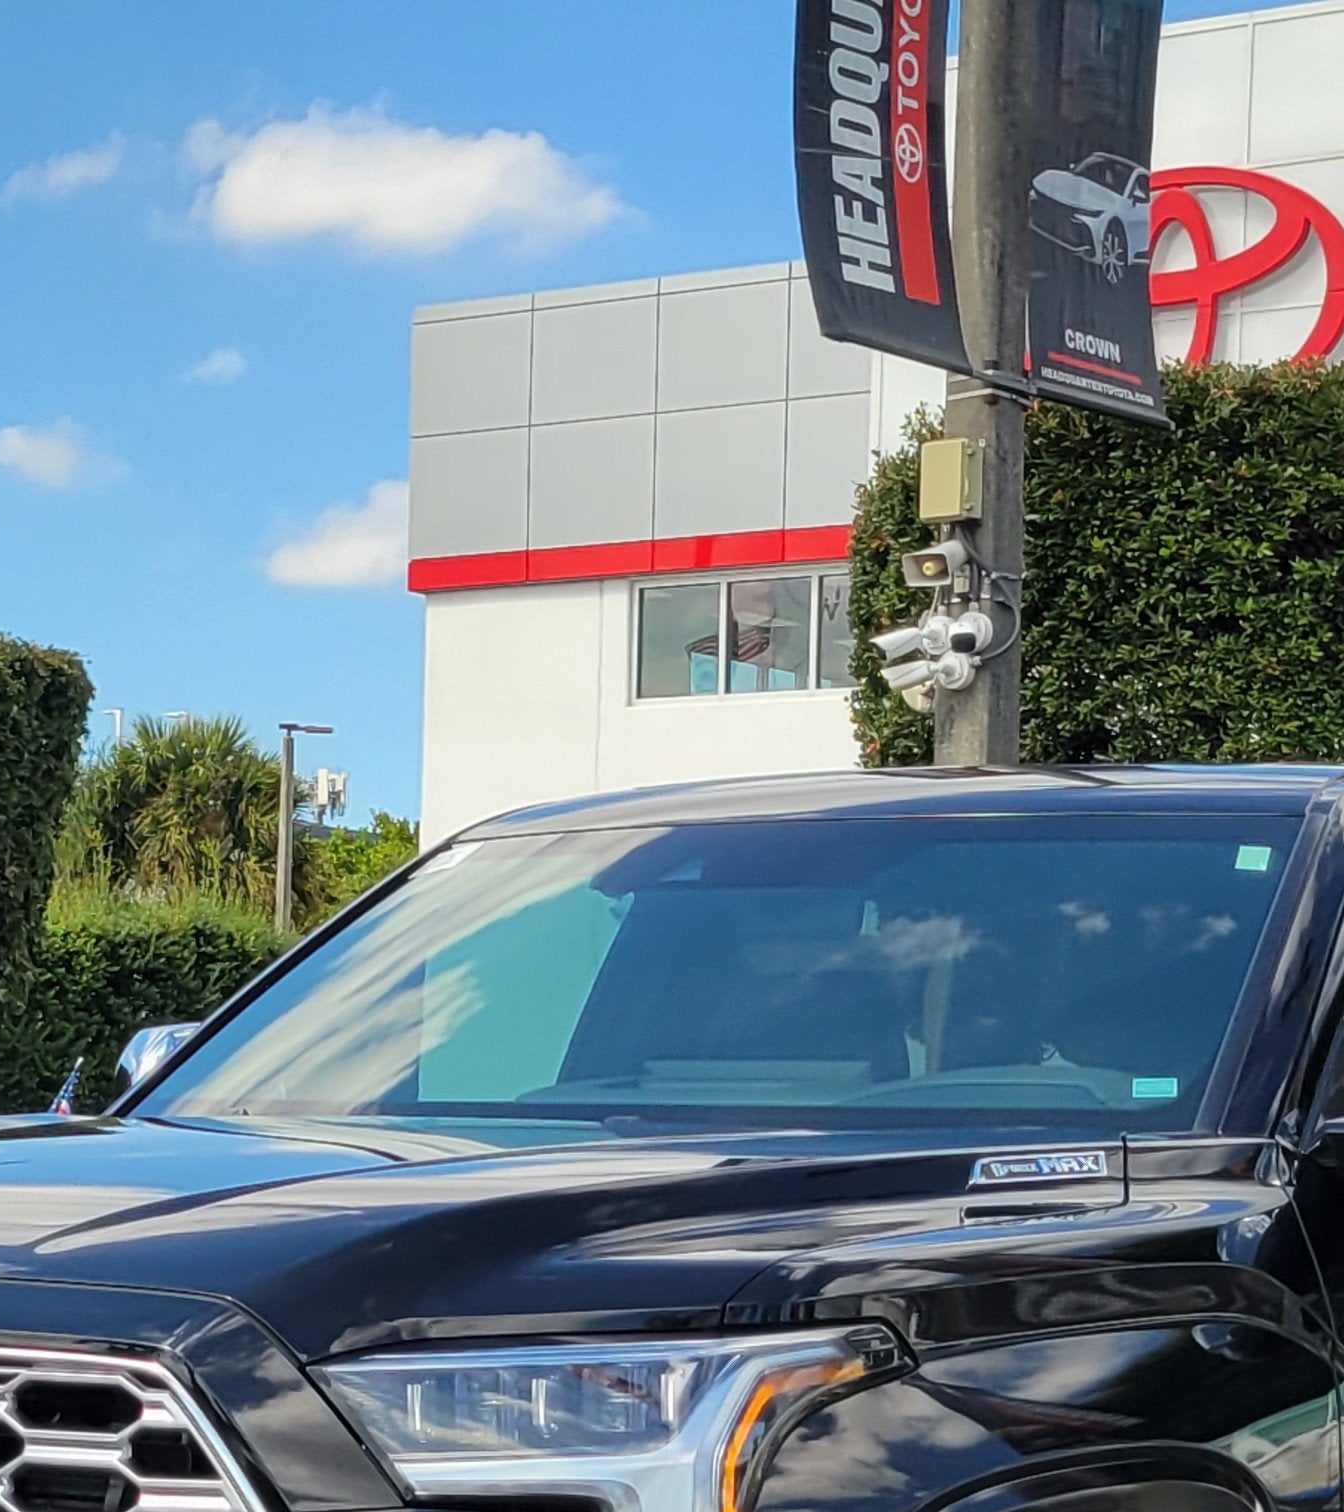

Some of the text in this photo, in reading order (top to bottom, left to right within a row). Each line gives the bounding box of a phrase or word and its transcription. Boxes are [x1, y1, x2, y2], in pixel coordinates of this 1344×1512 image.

[829, 0, 896, 293] HEADQU
[1064, 328, 1122, 364] CROWN
[1041, 1156, 1099, 1174] MAX
